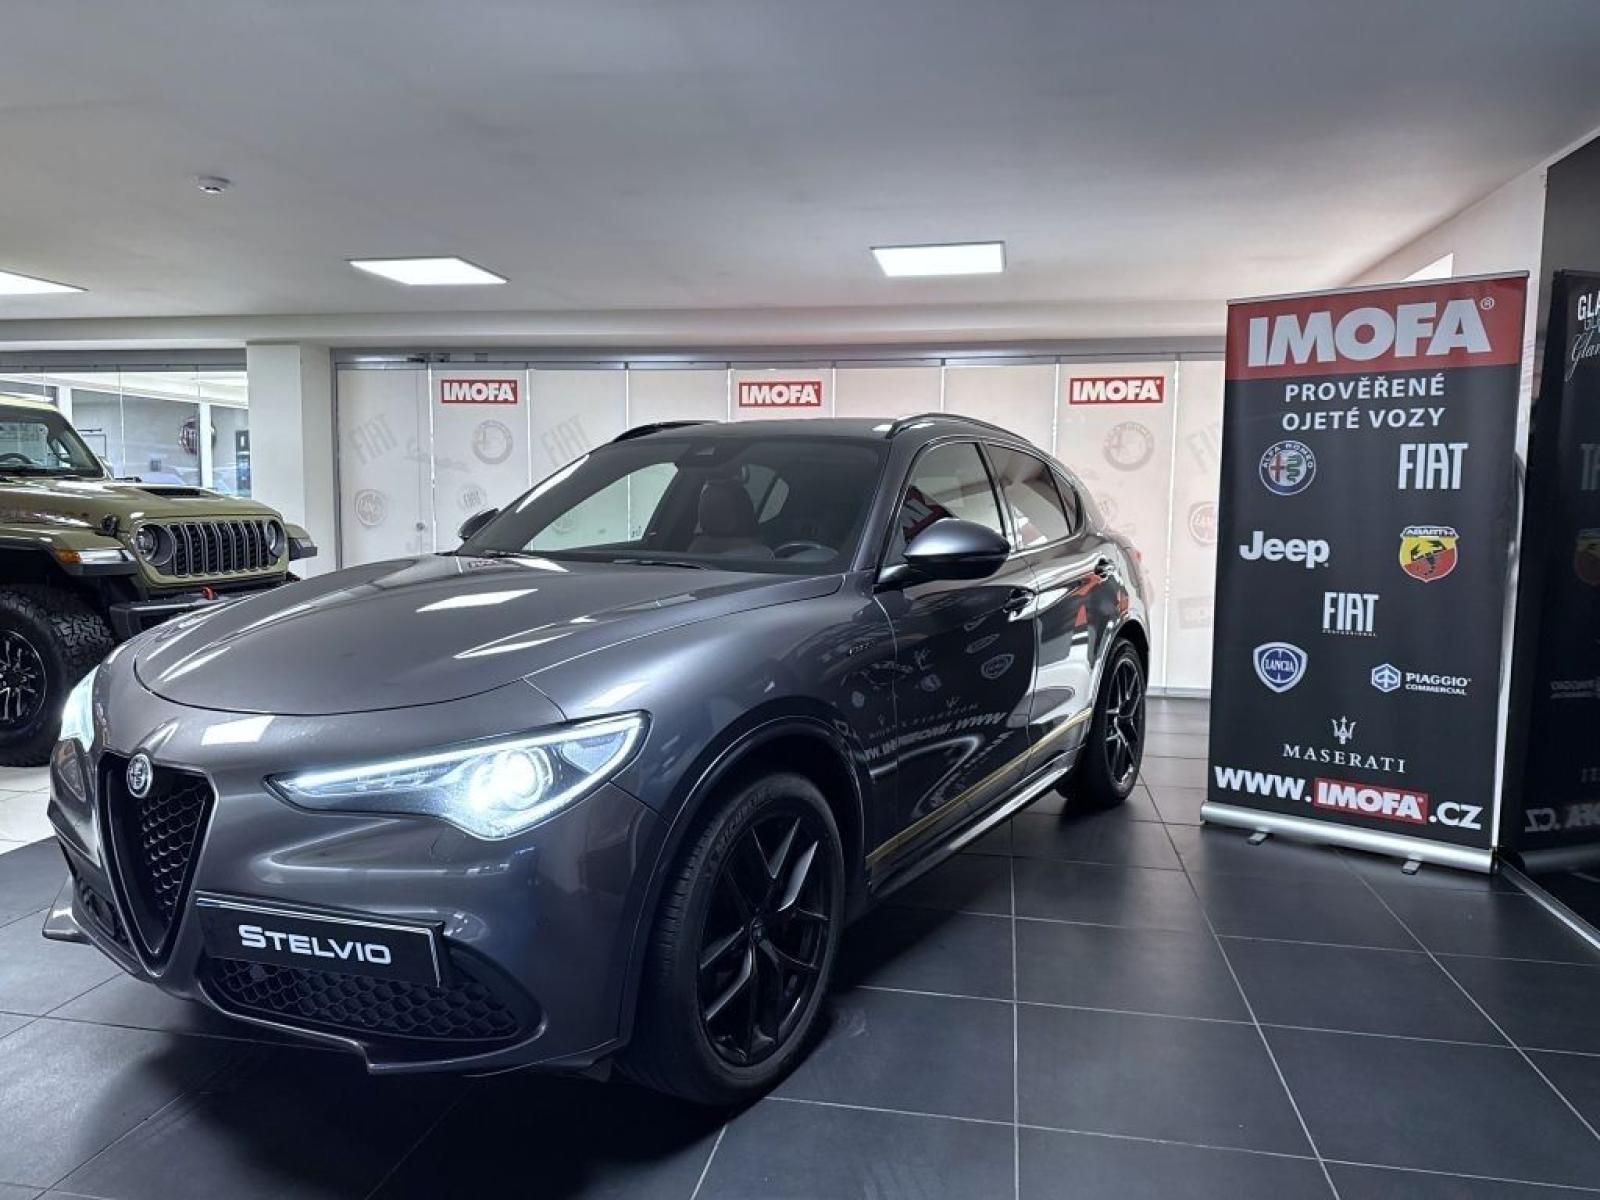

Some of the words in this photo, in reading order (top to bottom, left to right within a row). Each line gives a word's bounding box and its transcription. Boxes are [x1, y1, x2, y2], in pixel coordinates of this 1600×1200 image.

[1247, 299, 1492, 368] IMOFA
[443, 382, 514, 401] IMOFA
[741, 384, 818, 404] IMOFA
[1072, 379, 1161, 401] IMOFA
[1285, 373, 1446, 402] PROVĚŘENÉ
[1282, 407, 1360, 431] OJETÉ
[1369, 407, 1446, 429] VOZY
[1398, 442, 1469, 490] FIAT
[1239, 531, 1330, 569] Jeep
[1322, 591, 1380, 632] FIAT
[1405, 672, 1468, 687] PIAGGIO
[1282, 743, 1406, 773] MASERATI
[238, 924, 392, 965] STELVIO
